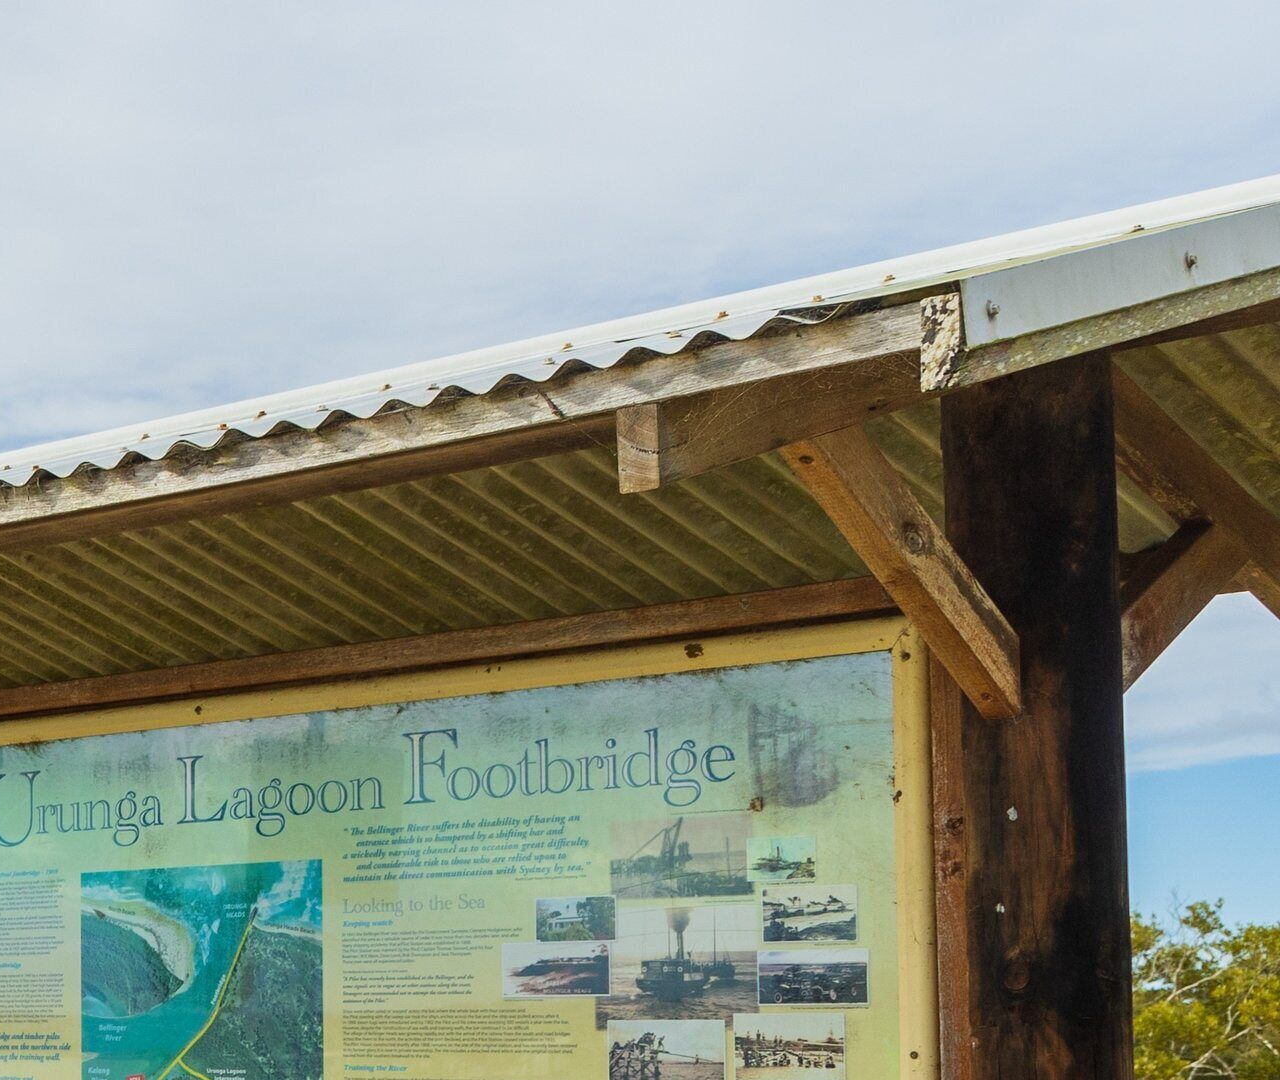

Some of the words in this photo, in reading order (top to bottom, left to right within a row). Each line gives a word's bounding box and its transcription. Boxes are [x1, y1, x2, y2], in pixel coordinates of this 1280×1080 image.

[177, 755, 385, 836] Lagoon
[402, 726, 736, 806] Footbridge
[367, 826, 404, 835] Bellinger
[407, 824, 429, 832] River
[432, 821, 459, 832] suffers
[462, 820, 475, 828] the
[478, 817, 520, 827] disability
[523, 815, 532, 827] of
[534, 815, 565, 824] having
[392, 836, 414, 844] which
[435, 832, 475, 843] hampered
[477, 831, 486, 840] by
[496, 829, 527, 840] shifting
[529, 828, 544, 836] bar
[546, 826, 564, 835] and
[351, 849, 386, 859] wickedly
[389, 849, 420, 857] varying
[423, 845, 456, 854] channel
[482, 843, 518, 851] occasion
[522, 841, 544, 851] great
[547, 837, 589, 849] difficulty
[357, 862, 371, 870] and
[373, 859, 421, 869] considerable
[424, 858, 439, 866] risk
[451, 857, 471, 865] those
[473, 855, 489, 864] who
[508, 853, 532, 862] relied
[344, 873, 380, 882] maintain
[384, 872, 395, 880] the
[399, 871, 423, 879] direct
[426, 868, 493, 878] communication
[496, 866, 516, 875] with
[520, 865, 551, 875] Sydney
[554, 863, 563, 874] by
[342, 898, 404, 917] Looking
[409, 897, 423, 911] to
[430, 895, 452, 910] the
[458, 894, 485, 910] Sea
[99, 1024, 127, 1032] Bellinger
[88, 1067, 110, 1075] Kalang
